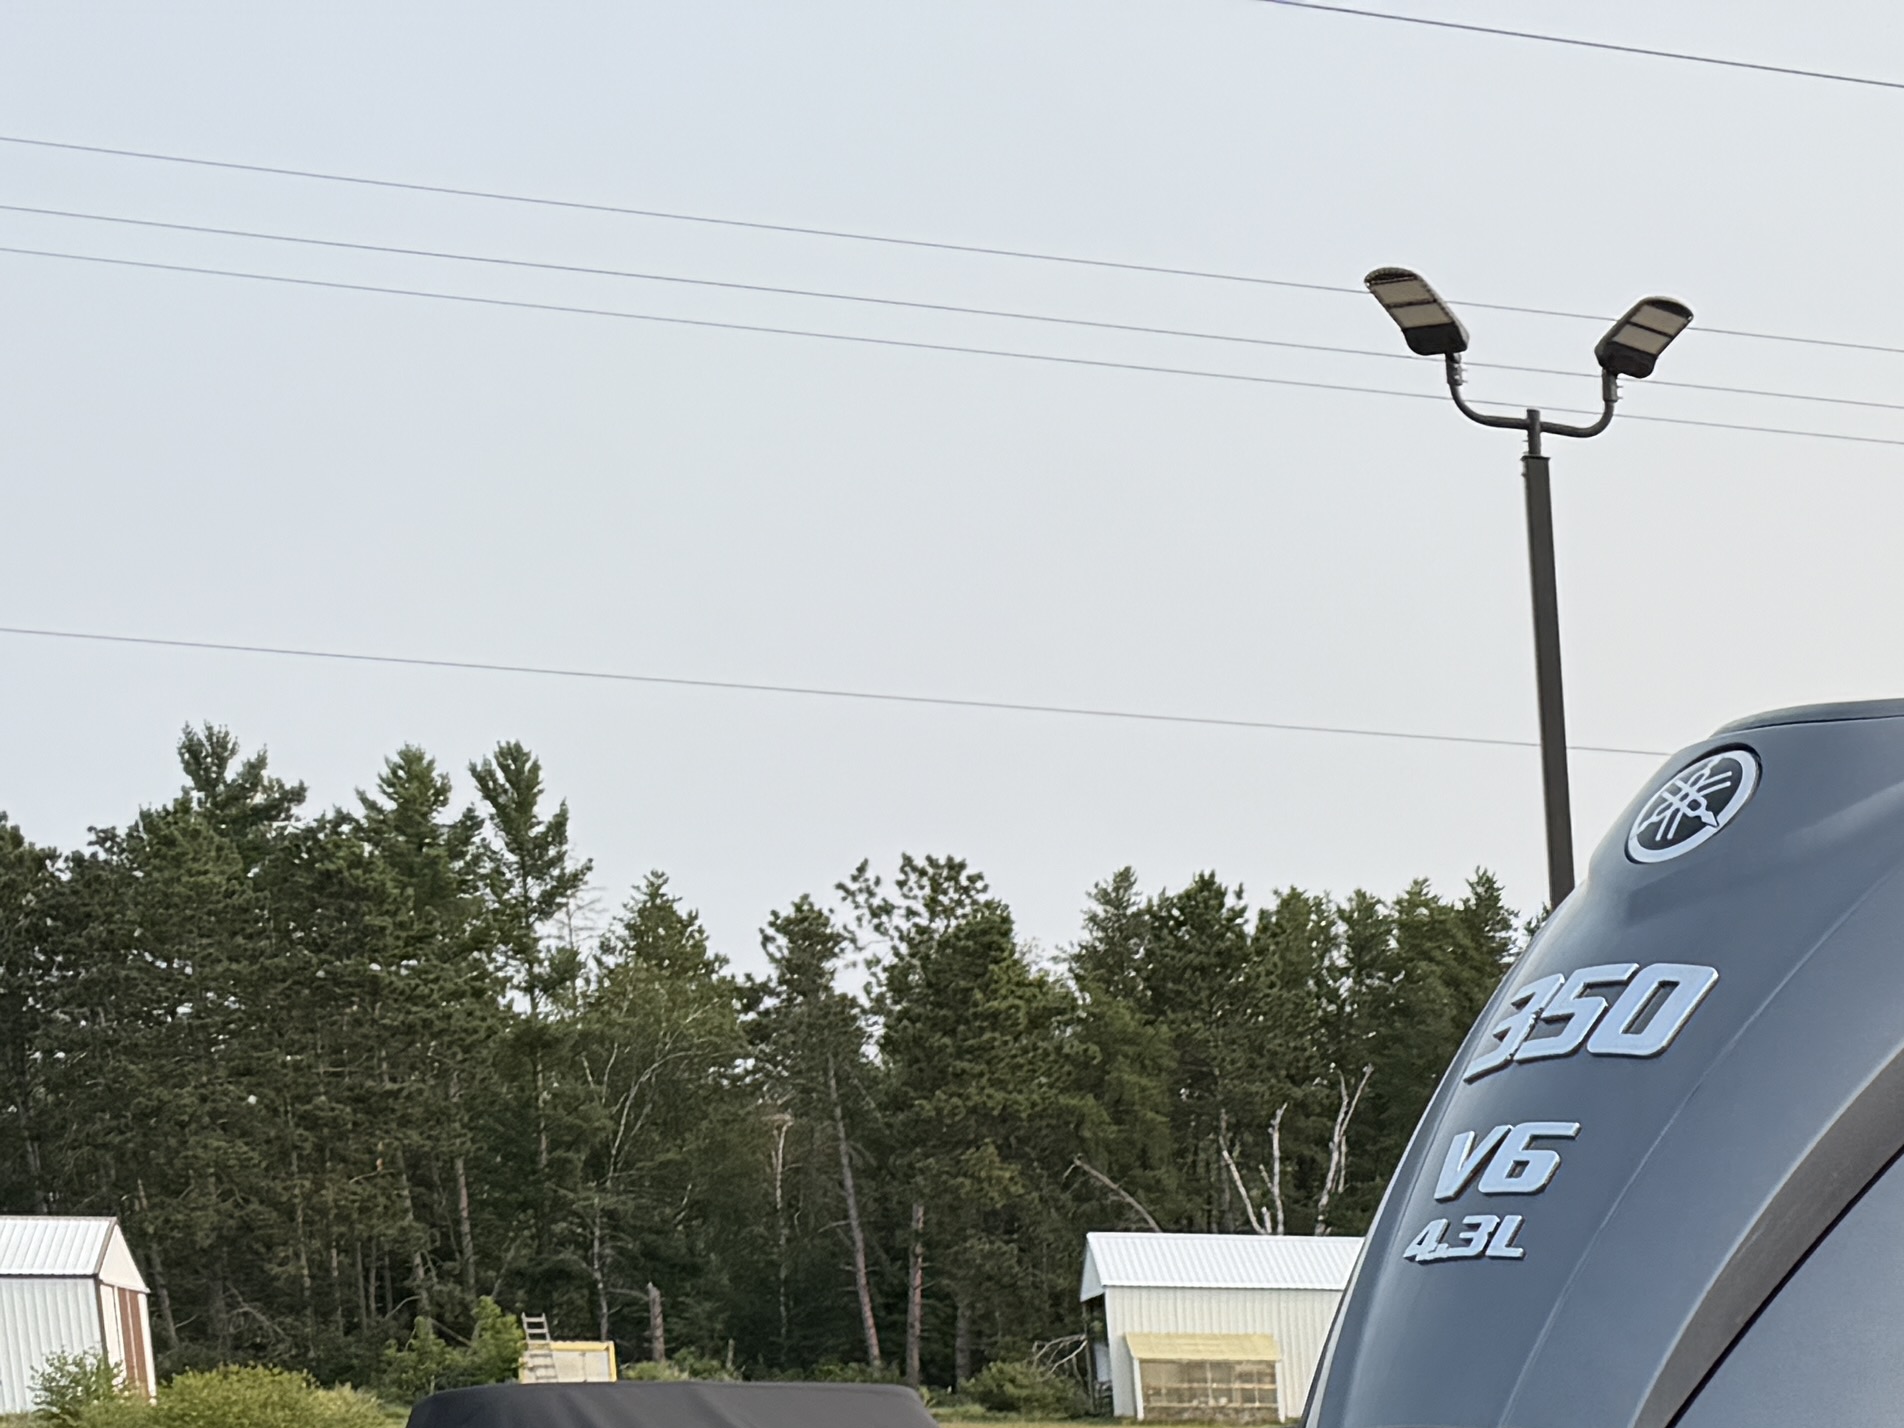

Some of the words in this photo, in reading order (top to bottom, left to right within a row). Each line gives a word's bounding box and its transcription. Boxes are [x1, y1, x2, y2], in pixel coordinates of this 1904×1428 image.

[1464, 962, 1719, 1085] 350
[1434, 1122, 1581, 1203] V6
[1403, 1214, 1526, 1265] 4.3L
